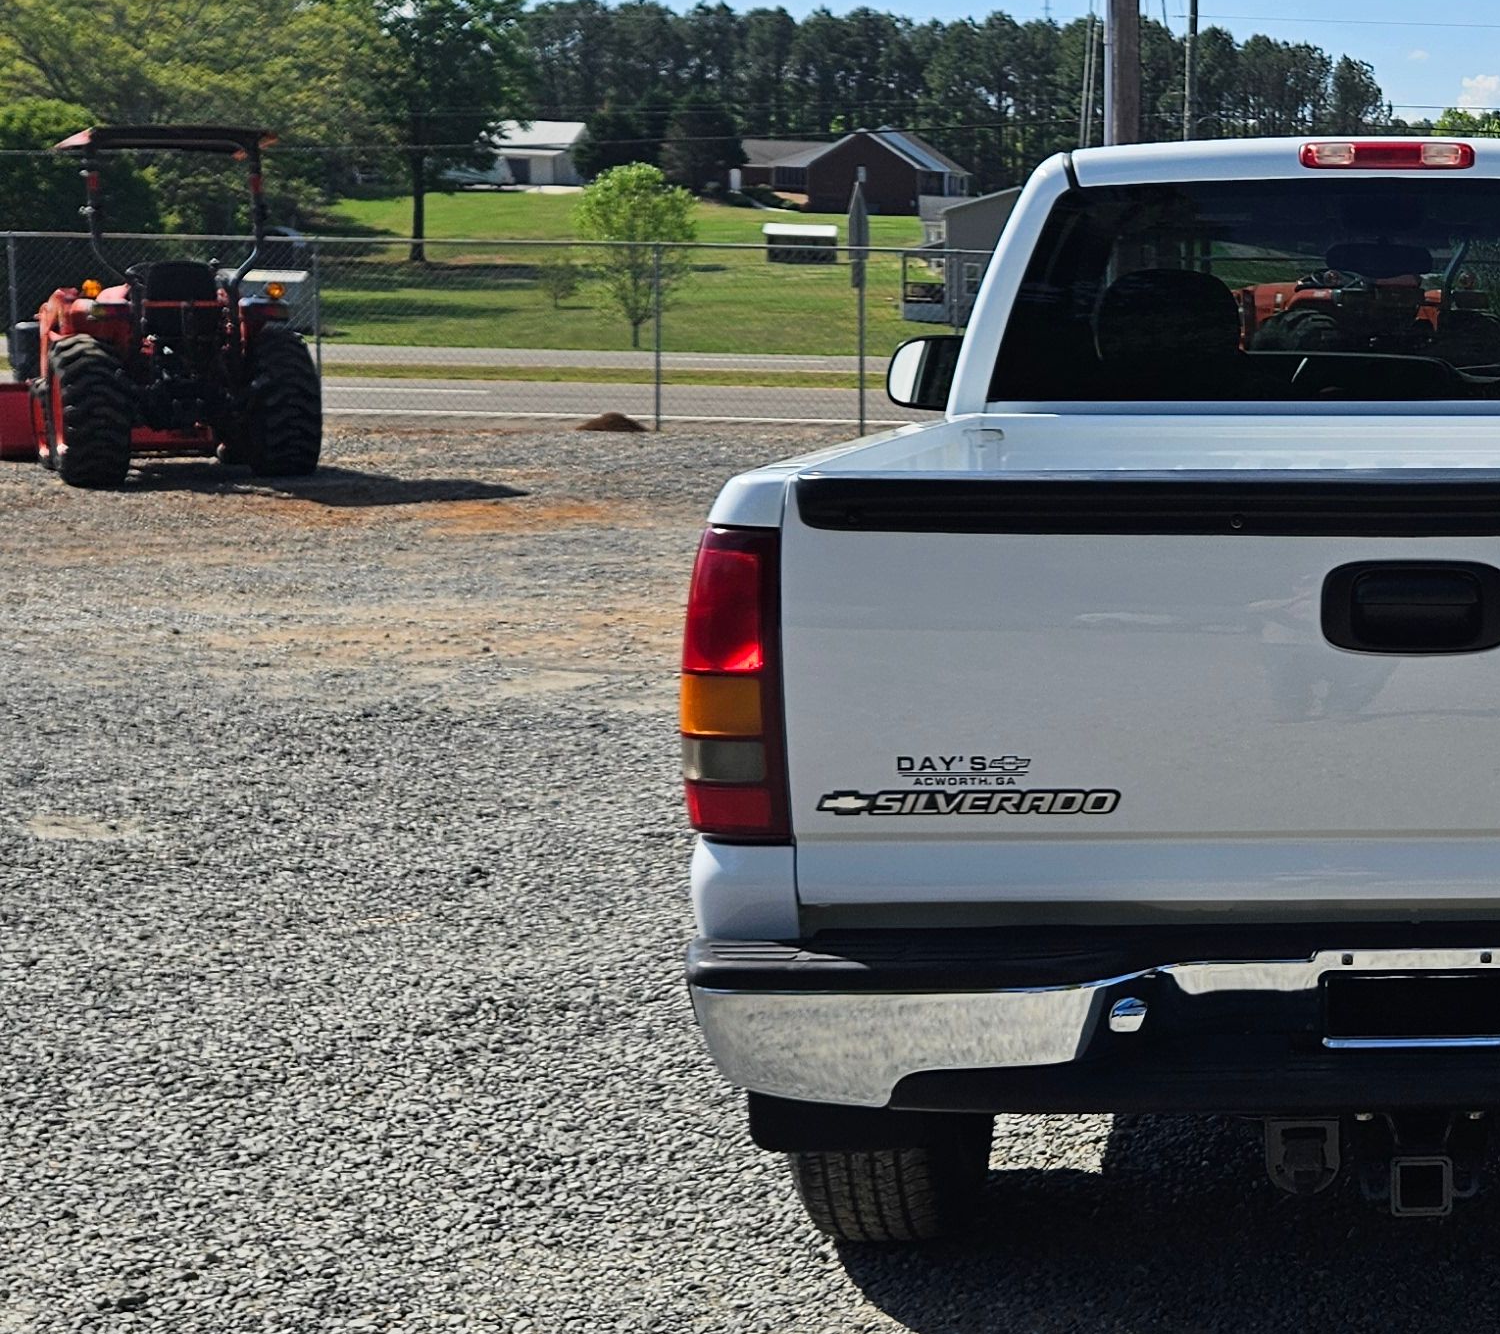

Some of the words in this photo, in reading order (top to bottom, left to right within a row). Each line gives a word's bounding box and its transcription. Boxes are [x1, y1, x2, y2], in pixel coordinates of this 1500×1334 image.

[897, 756, 987, 771] DAY'S
[996, 777, 1016, 786] GA
[869, 790, 1121, 815] SILVERADO
